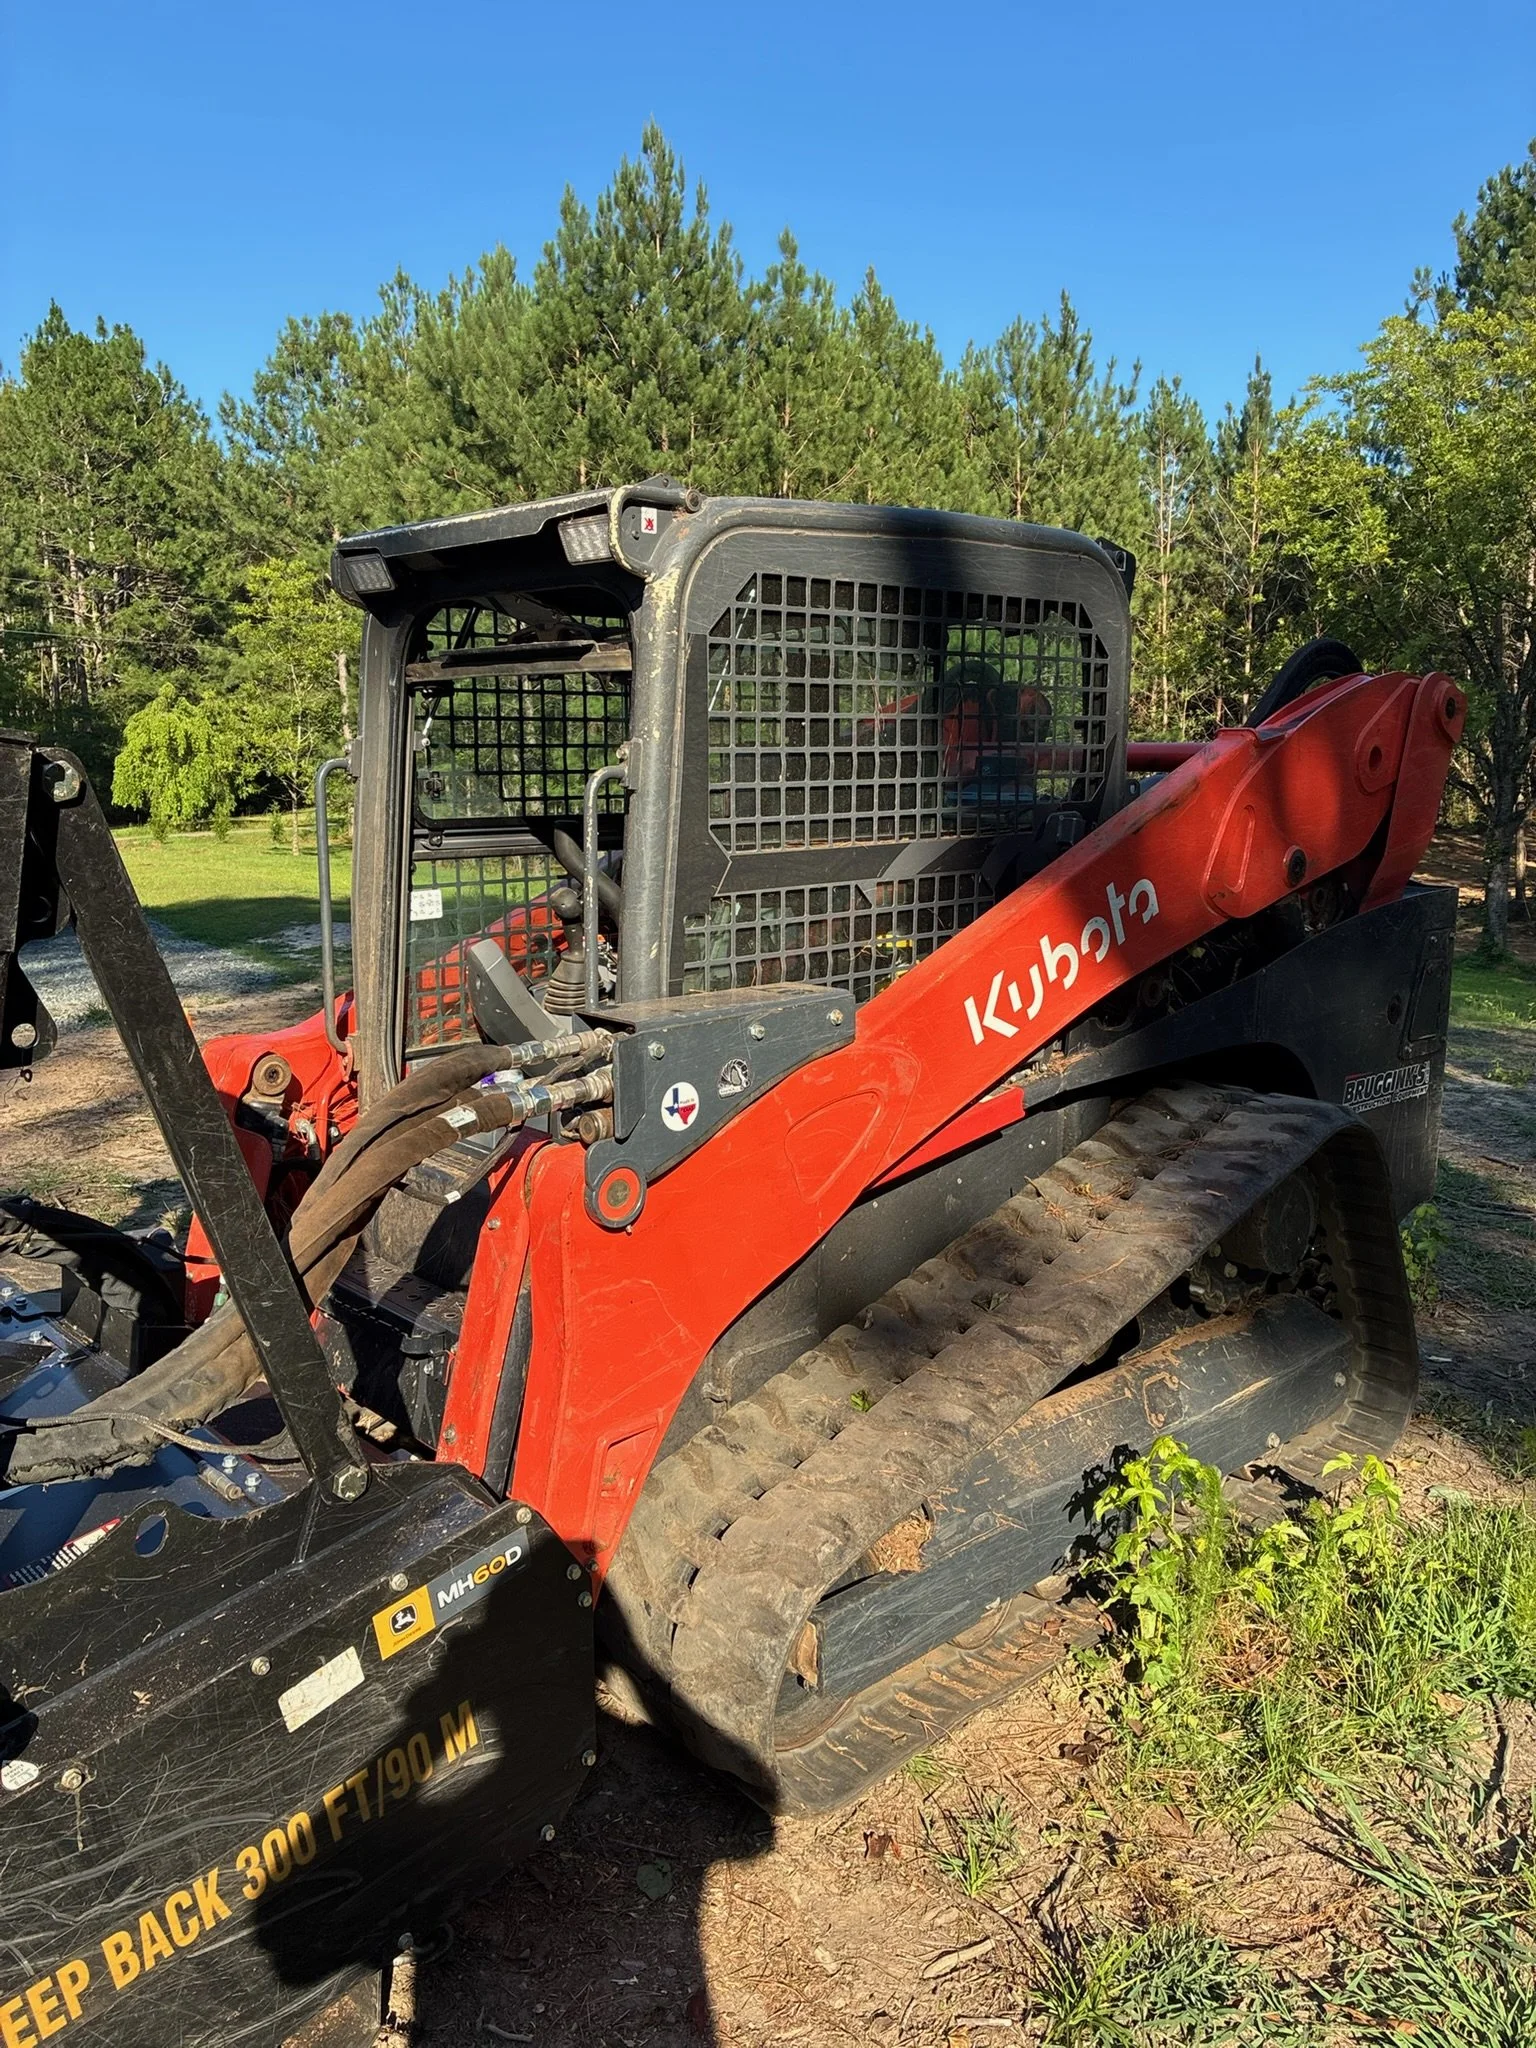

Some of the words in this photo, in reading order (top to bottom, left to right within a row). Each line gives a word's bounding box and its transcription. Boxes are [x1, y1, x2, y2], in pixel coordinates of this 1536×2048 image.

[963, 878, 1160, 1046] Kubota
[436, 1545, 522, 1609] MH60D
[101, 1867, 232, 1991] BACK
[235, 1811, 317, 1900] 300
[322, 1732, 436, 1842] FT/90
[440, 1700, 481, 1763] M
